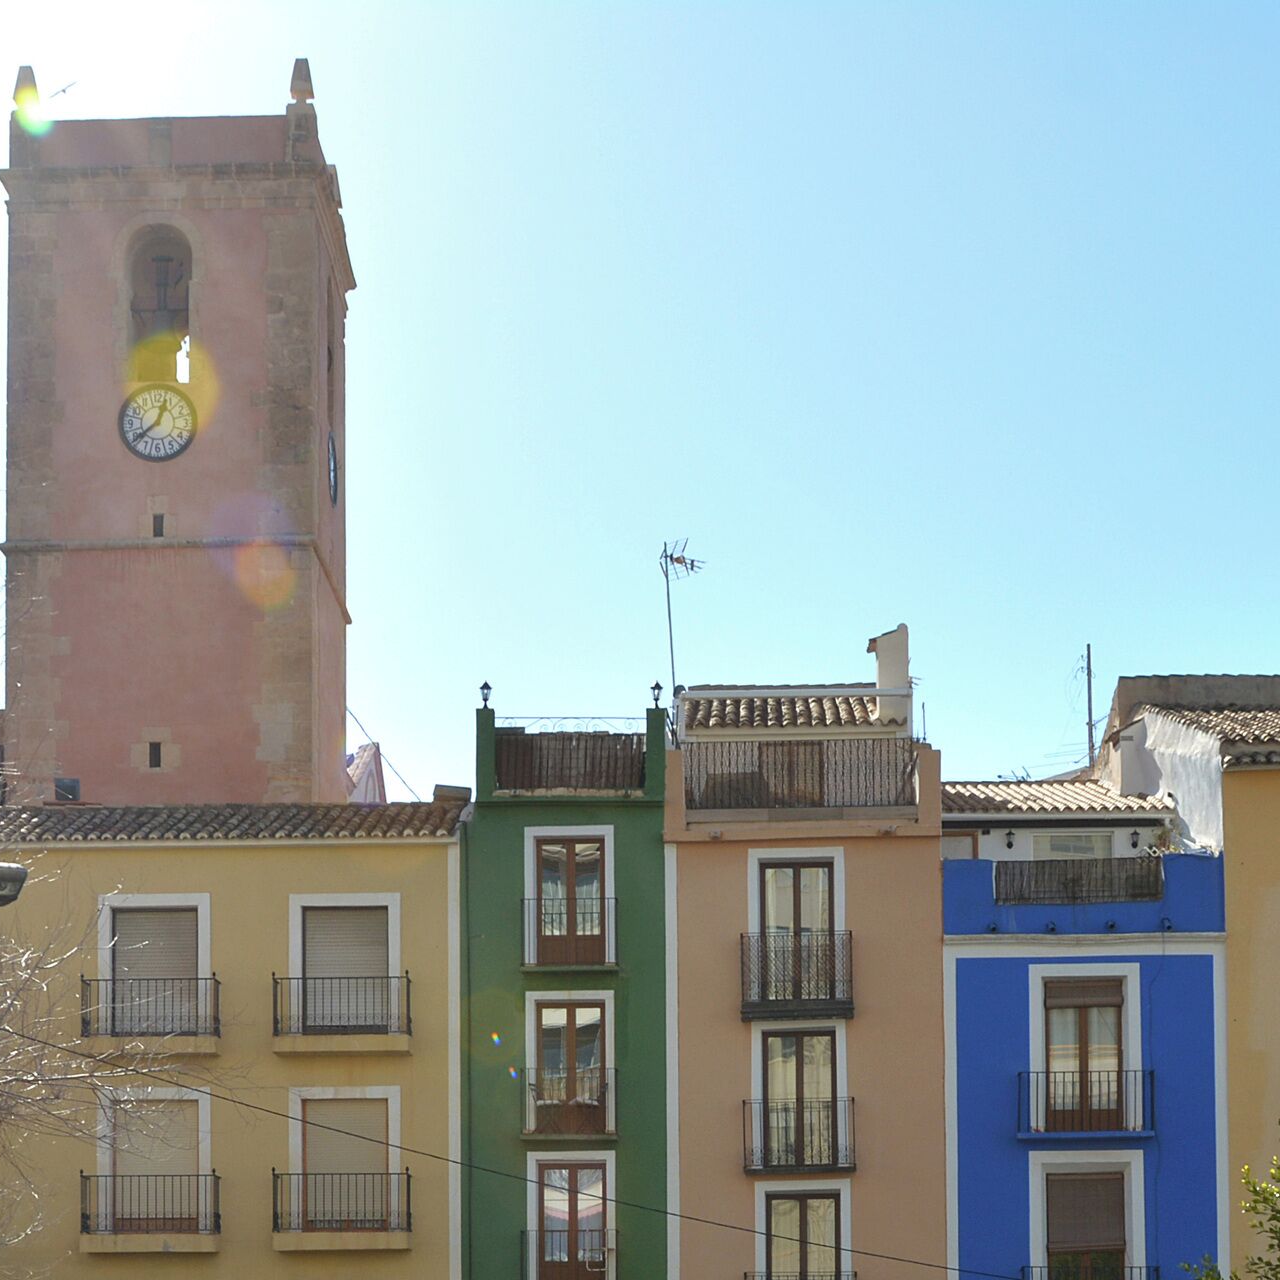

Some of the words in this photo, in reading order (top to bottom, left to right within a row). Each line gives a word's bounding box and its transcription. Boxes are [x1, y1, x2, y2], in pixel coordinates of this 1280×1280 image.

[153, 393, 163, 403] 12
[178, 405, 184, 415] 2
[127, 420, 134, 429] 9
[154, 443, 161, 453] 6
